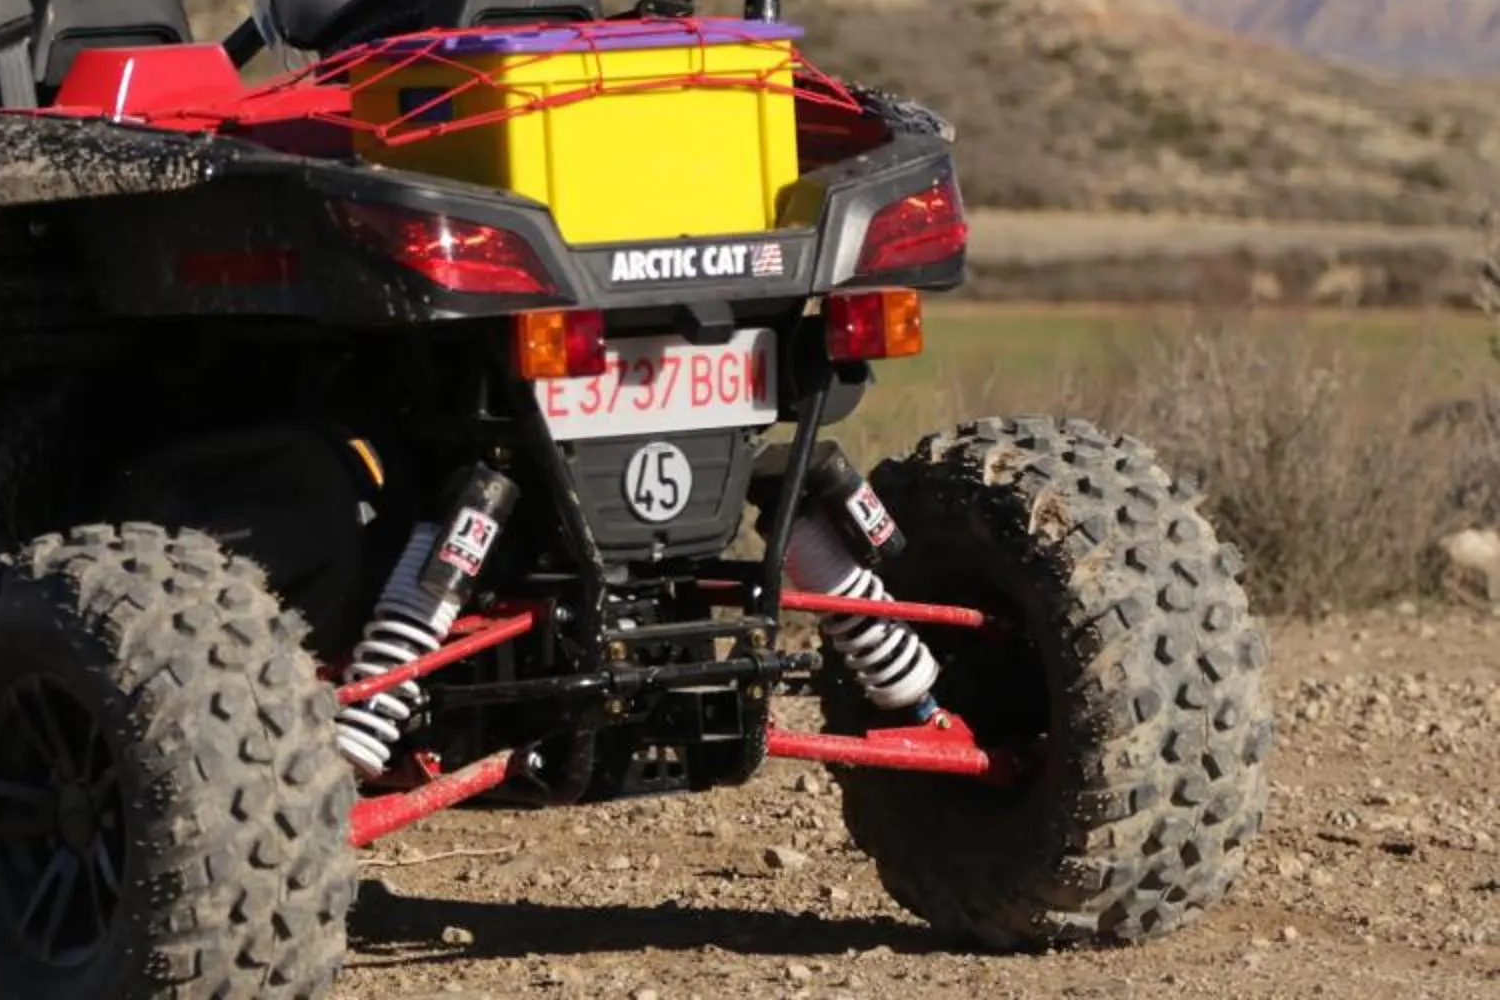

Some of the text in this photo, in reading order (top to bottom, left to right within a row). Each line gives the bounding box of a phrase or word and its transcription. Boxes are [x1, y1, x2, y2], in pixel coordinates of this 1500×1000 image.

[611, 244, 748, 282] ARCTIC CAT
[579, 356, 682, 415] 3737
[634, 451, 680, 512] 45
